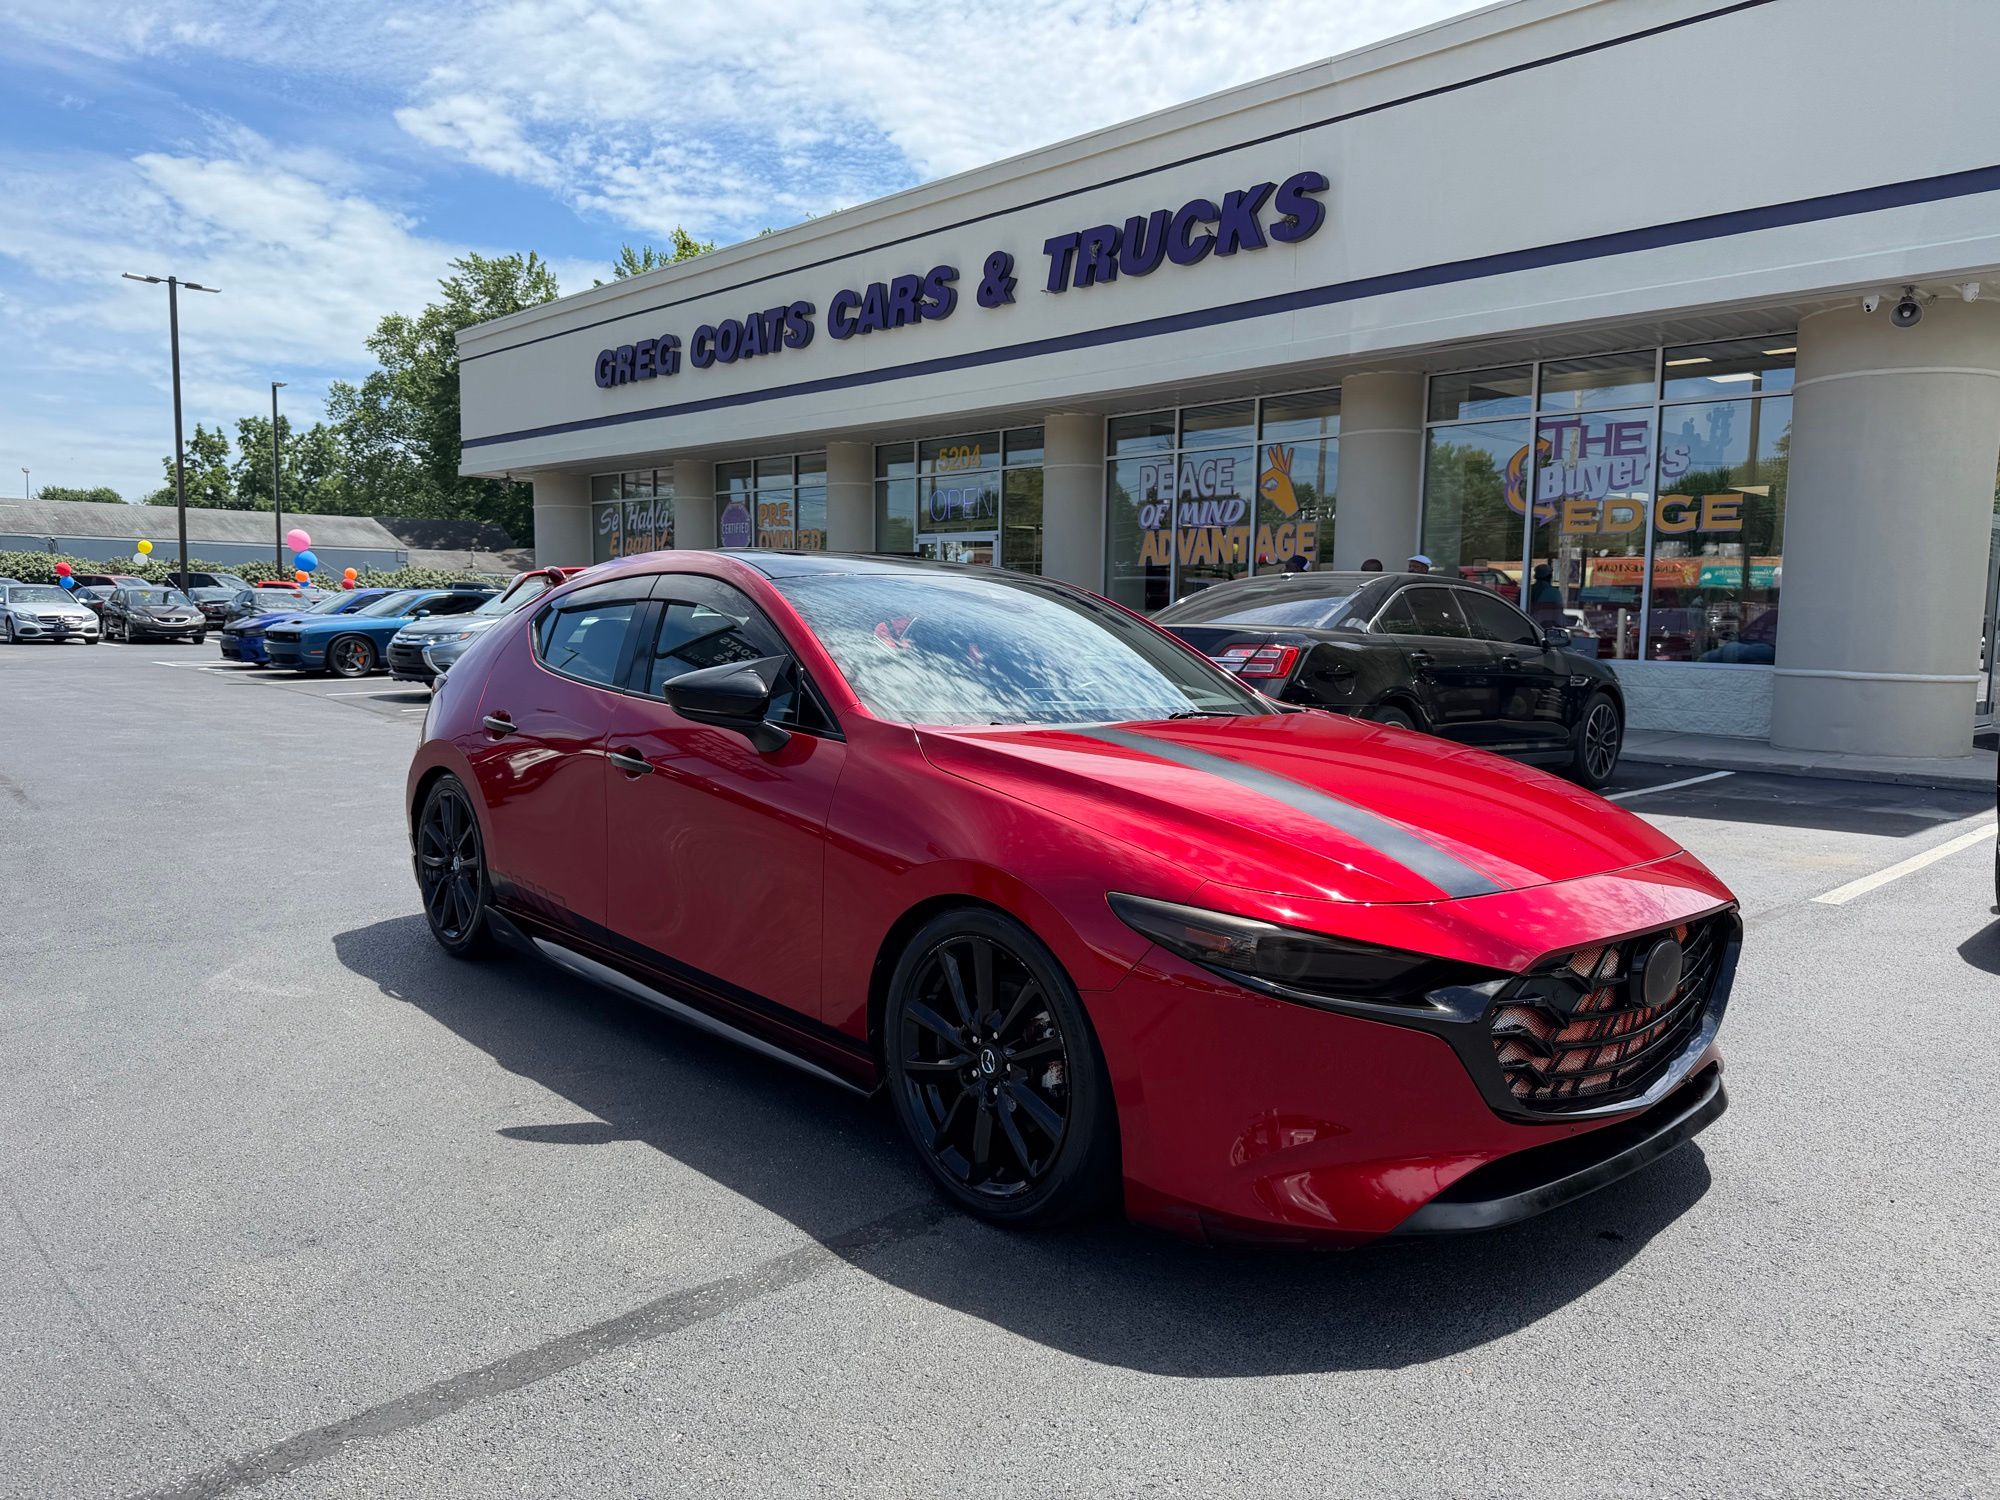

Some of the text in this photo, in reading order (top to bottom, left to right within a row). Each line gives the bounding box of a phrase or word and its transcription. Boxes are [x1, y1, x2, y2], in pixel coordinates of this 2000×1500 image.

[595, 171, 1330, 388] GREG COATS CARS & TRUCKS
[938, 444, 982, 472] 5204
[1536, 419, 1648, 461] THE
[1139, 458, 1235, 500] PEACE
[599, 503, 673, 535] Se Habla
[930, 483, 996, 522] OPEN
[1139, 499, 1246, 529] OF MIND
[1561, 493, 1744, 535] EDGE
[722, 522, 750, 535] CERTIFIED
[758, 529, 820, 549] OWNED
[1138, 522, 1317, 566] ADVANTAGE
